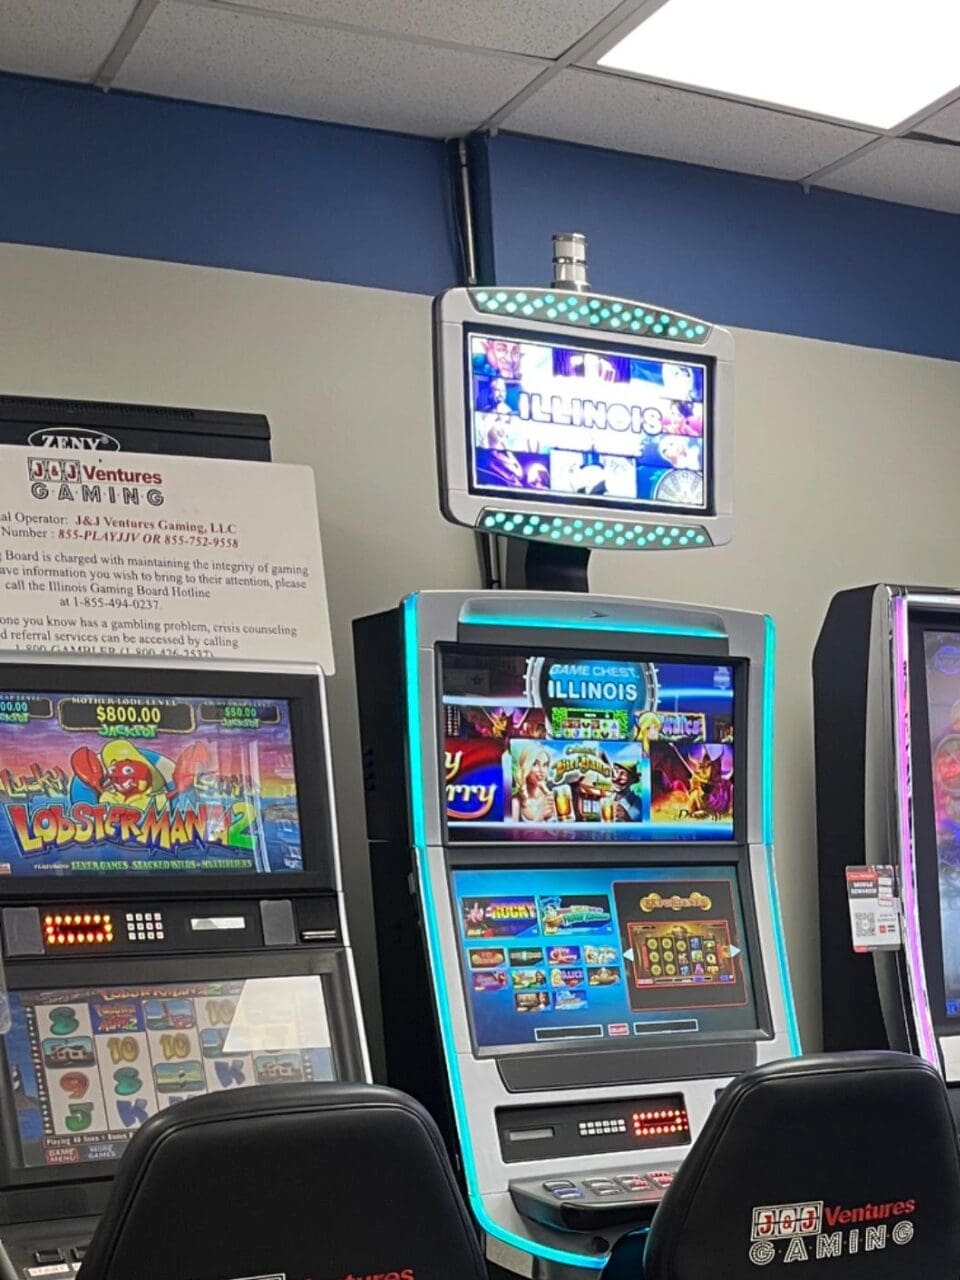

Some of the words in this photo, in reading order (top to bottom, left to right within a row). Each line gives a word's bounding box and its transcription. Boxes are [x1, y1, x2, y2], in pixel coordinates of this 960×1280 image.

[518, 391, 663, 436] ILLINOIS
[42, 435, 100, 450] ZENY
[31, 459, 79, 481] J&J
[82, 465, 163, 484] Ventures
[31, 482, 164, 506] GAMING
[75, 515, 100, 526] J&J
[104, 516, 154, 529] Ventures
[158, 520, 207, 534] Gaming,
[210, 523, 238, 534] LLC
[2, 526, 47, 538] Number
[58, 529, 140, 542] 855-PLAYJJV
[143, 535, 161, 544] OR
[164, 536, 239, 548] 855-752-9558
[5, 550, 39, 562] Board
[42, 551, 51, 562] is
[55, 552, 97, 566] charged
[101, 554, 125, 565] with
[127, 556, 190, 570] maintaining
[193, 559, 209, 570] the
[212, 561, 254, 574] integrity
[257, 563, 268, 573] of
[271, 565, 309, 577] gaming
[5, 579, 25, 590] call
[28, 580, 46, 591] the
[49, 580, 87, 593] Illinois
[90, 583, 134, 597] Gaming
[136, 585, 169, 596] Board
[171, 587, 211, 598] Hotline
[22, 565, 86, 578] information
[90, 570, 110, 581] you
[113, 570, 138, 581] wish
[141, 572, 152, 581] to
[154, 571, 183, 585] bring
[185, 574, 196, 583] to
[198, 573, 223, 585] their
[225, 576, 273, 588] attention,
[275, 578, 307, 590] please
[59, 598, 70, 607] at
[74, 597, 159, 610] 1-855-494-0237
[23, 617, 43, 629] you
[46, 615, 77, 627] know
[80, 617, 99, 628] has
[111, 618, 161, 634] gambling
[163, 621, 211, 634] problem,
[213, 623, 240, 634] crisis
[242, 624, 297, 637] counseling
[11, 629, 51, 641] referral
[54, 632, 99, 642] services
[101, 633, 120, 643] can
[122, 631, 136, 644] be
[138, 634, 184, 646] accessed
[187, 636, 201, 648] by
[203, 637, 239, 649] calling
[549, 664, 590, 678] GAME
[548, 680, 637, 701] ILLINOIS
[96, 705, 161, 723] $800.00
[98, 724, 158, 738] JACKPOT
[229, 802, 257, 849] 2
[755, 1205, 819, 1238] J&J
[825, 1199, 916, 1227] Ventures
[749, 1220, 914, 1266] GAMING
